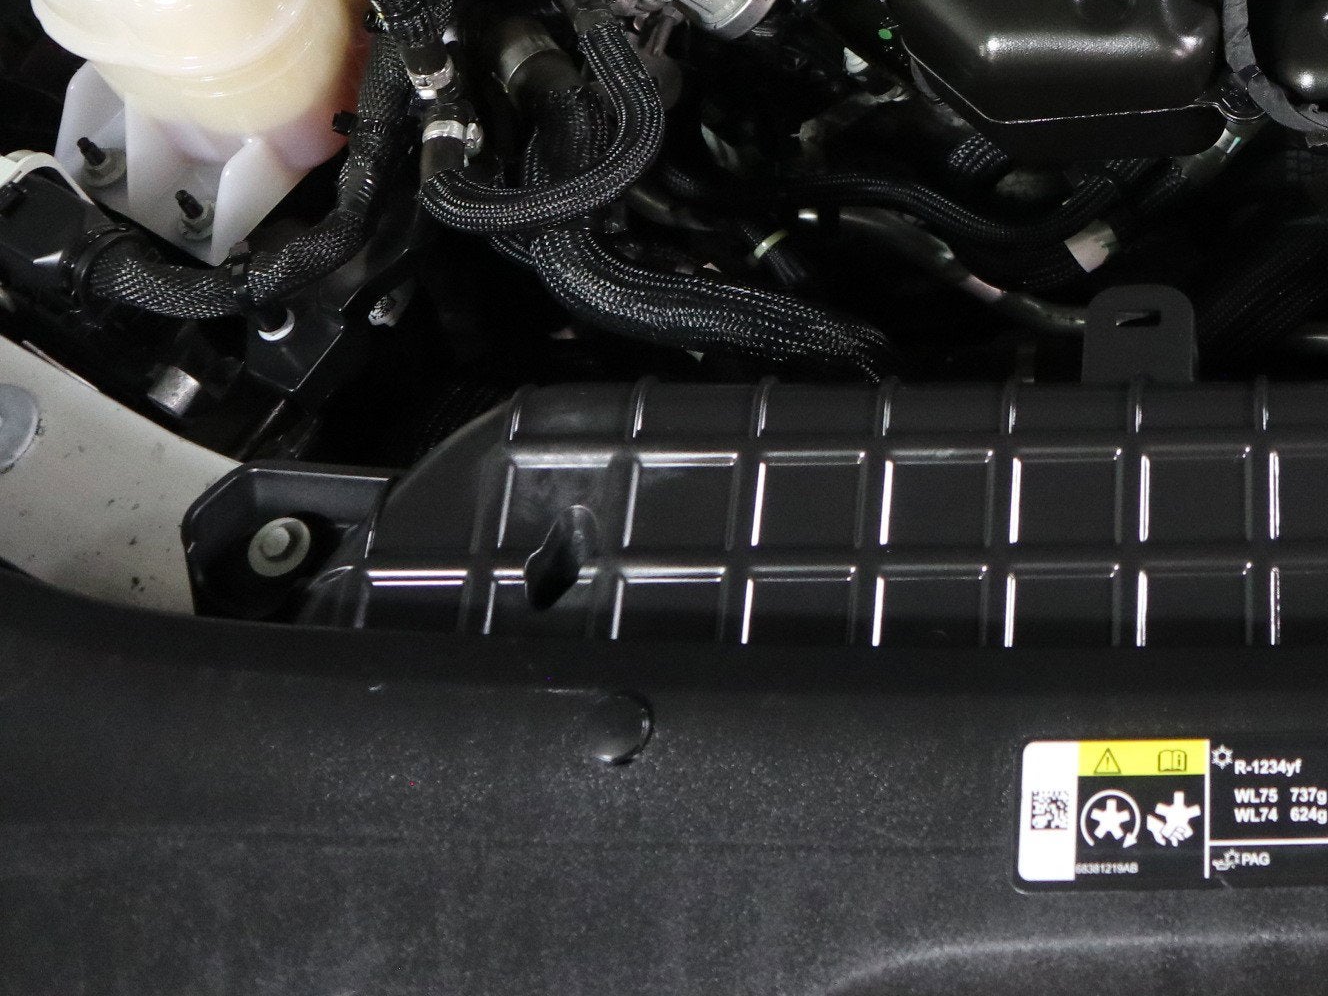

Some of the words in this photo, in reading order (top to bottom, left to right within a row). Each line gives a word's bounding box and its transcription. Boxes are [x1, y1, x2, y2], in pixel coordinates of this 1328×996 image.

[1234, 758, 1303, 777] R-1234yf
[1234, 788, 1278, 804] WL75
[1290, 787, 1328, 805] 737g
[1234, 807, 1278, 823] WL74
[1290, 806, 1328, 824] 624g
[1241, 852, 1270, 866] PAG
